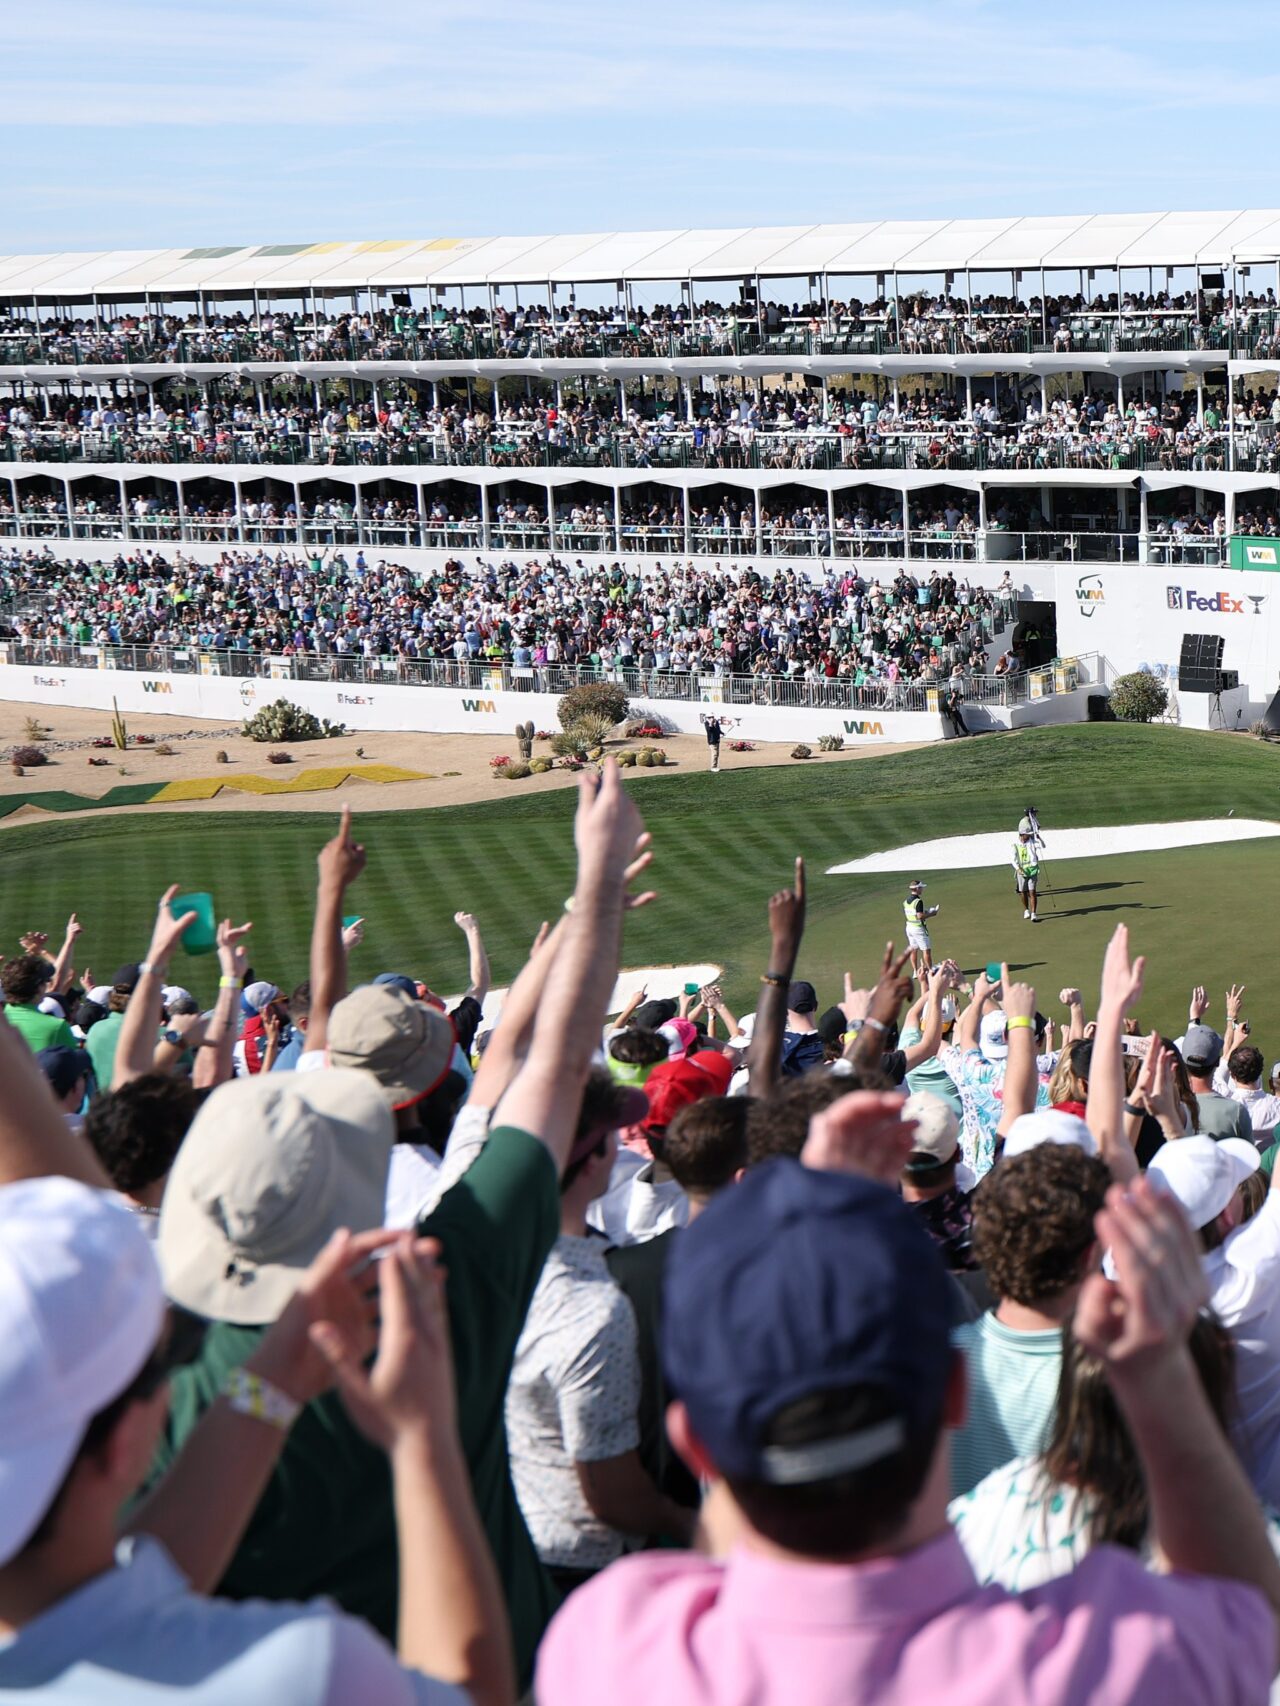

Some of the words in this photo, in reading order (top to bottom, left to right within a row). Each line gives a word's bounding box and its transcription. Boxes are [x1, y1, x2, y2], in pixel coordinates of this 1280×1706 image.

[1252, 551, 1272, 560] WM
[1075, 589, 1105, 600] WM
[1186, 590, 1244, 614] FedEx
[142, 680, 173, 694] WM
[462, 699, 497, 713] WM
[843, 720, 884, 735] WM
